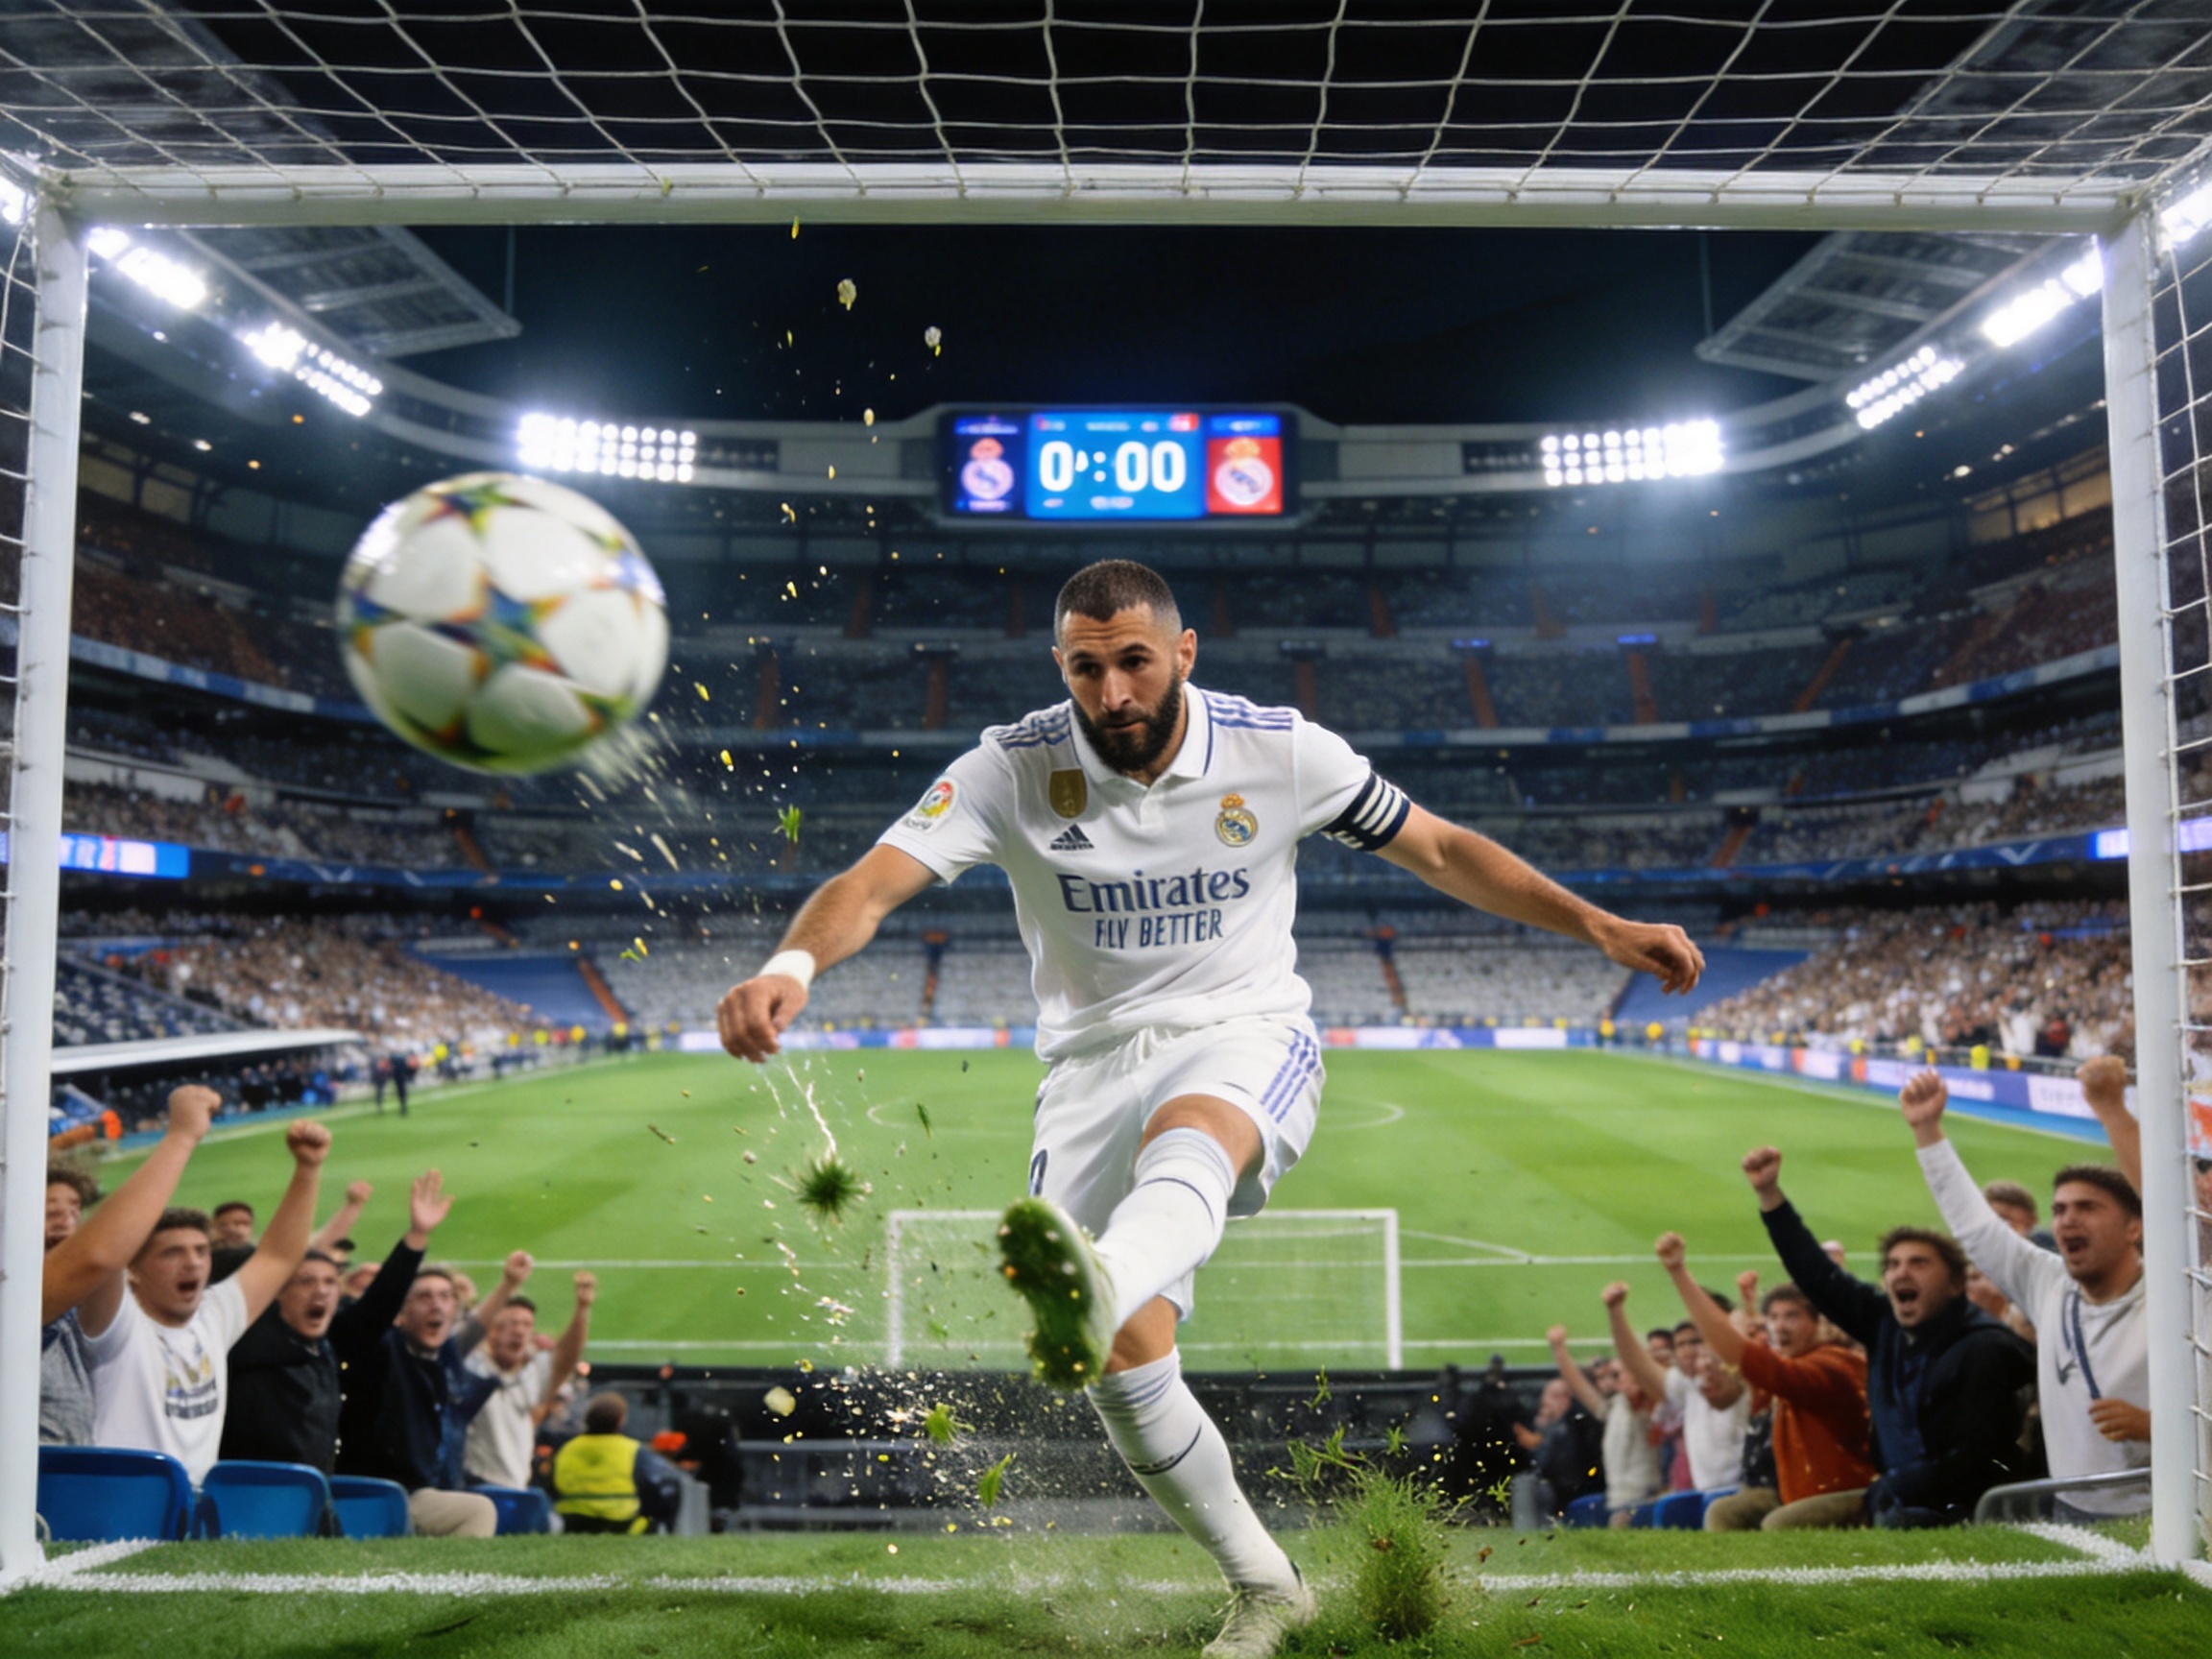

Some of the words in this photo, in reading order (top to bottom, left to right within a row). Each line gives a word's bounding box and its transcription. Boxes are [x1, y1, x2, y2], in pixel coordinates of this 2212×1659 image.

[1055, 866, 1250, 912] Emirates
[1094, 918, 1129, 949] FLY
[1140, 908, 1223, 948] BETTER
